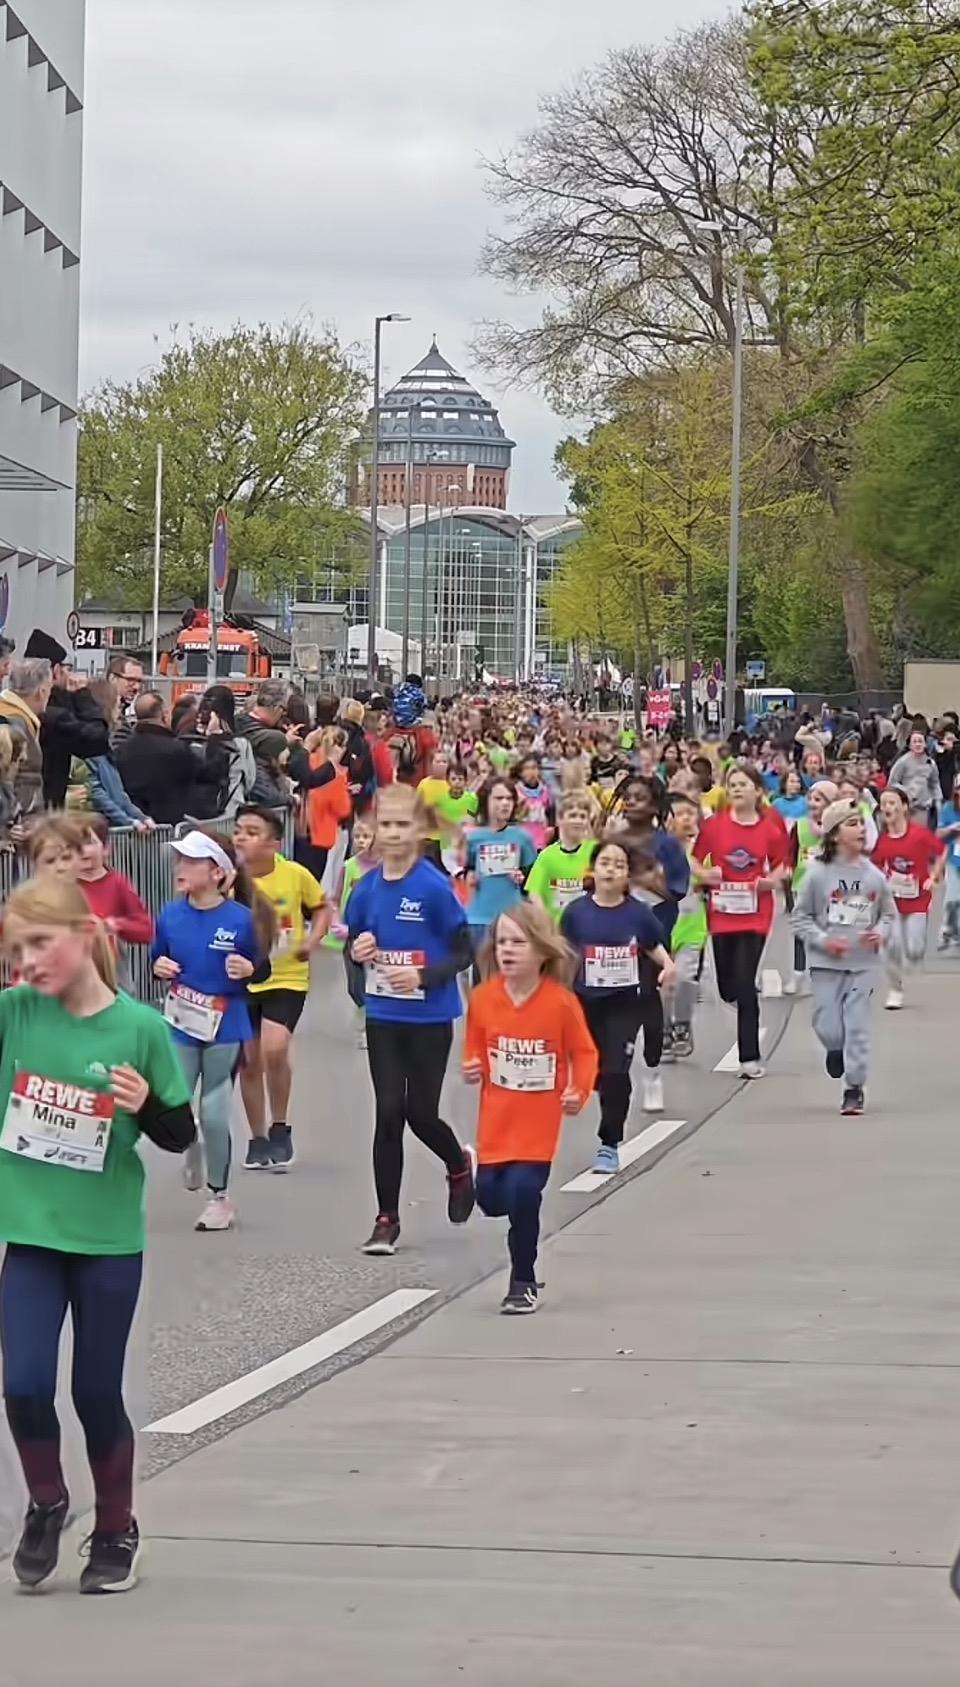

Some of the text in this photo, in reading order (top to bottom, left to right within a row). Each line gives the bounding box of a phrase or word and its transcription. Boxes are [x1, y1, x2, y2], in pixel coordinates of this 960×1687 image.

[498, 1036, 545, 1054] REWE
[24, 1075, 97, 1114] REWE
[32, 1103, 76, 1130] Mina
